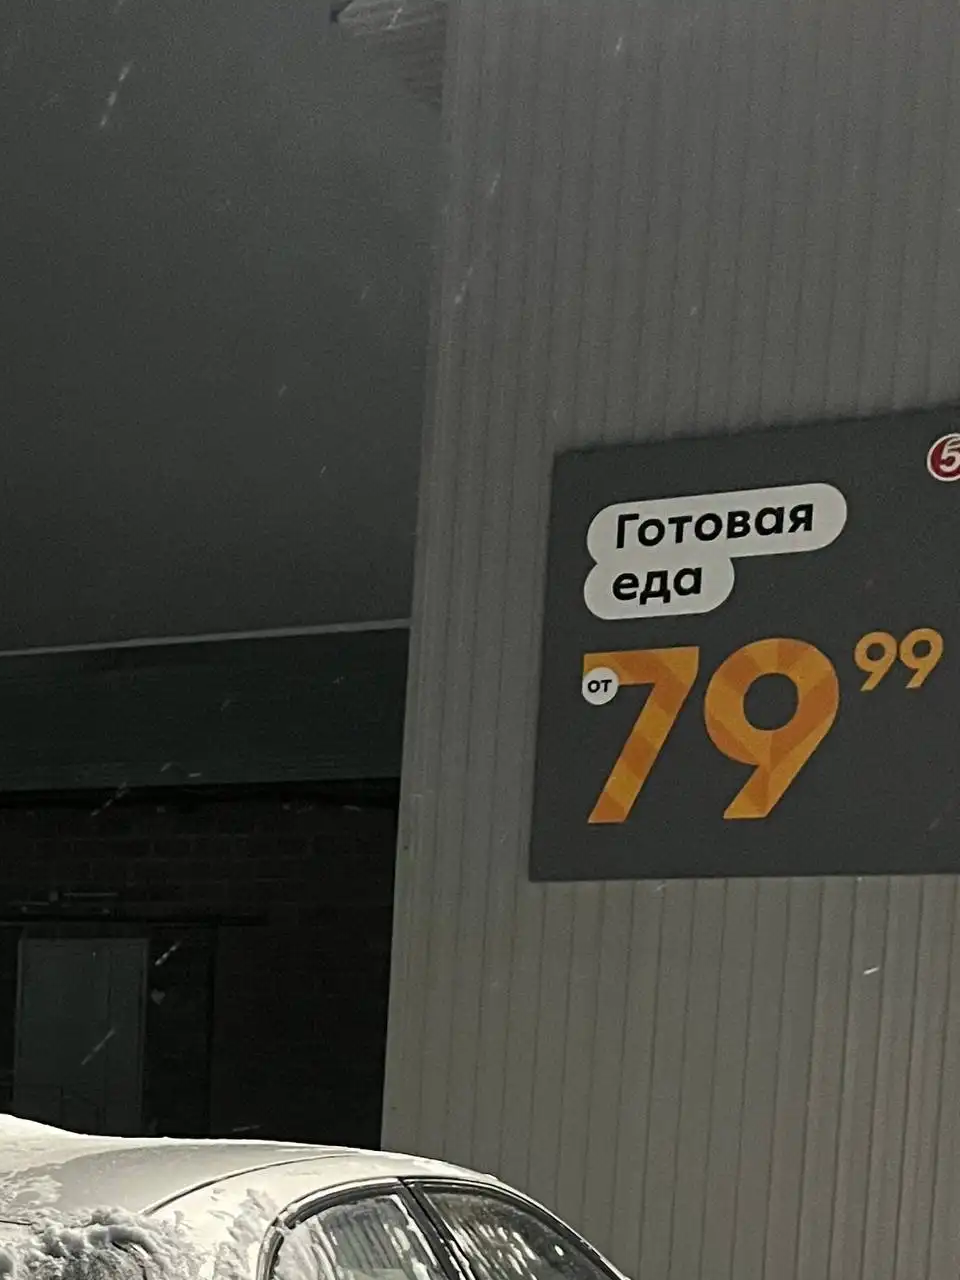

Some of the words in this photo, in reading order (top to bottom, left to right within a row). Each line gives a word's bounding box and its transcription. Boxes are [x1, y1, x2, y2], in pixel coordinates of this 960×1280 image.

[615, 503, 814, 549] Готовая
[612, 566, 703, 605] еда
[583, 637, 839, 823] 79
[854, 628, 944, 691] 99
